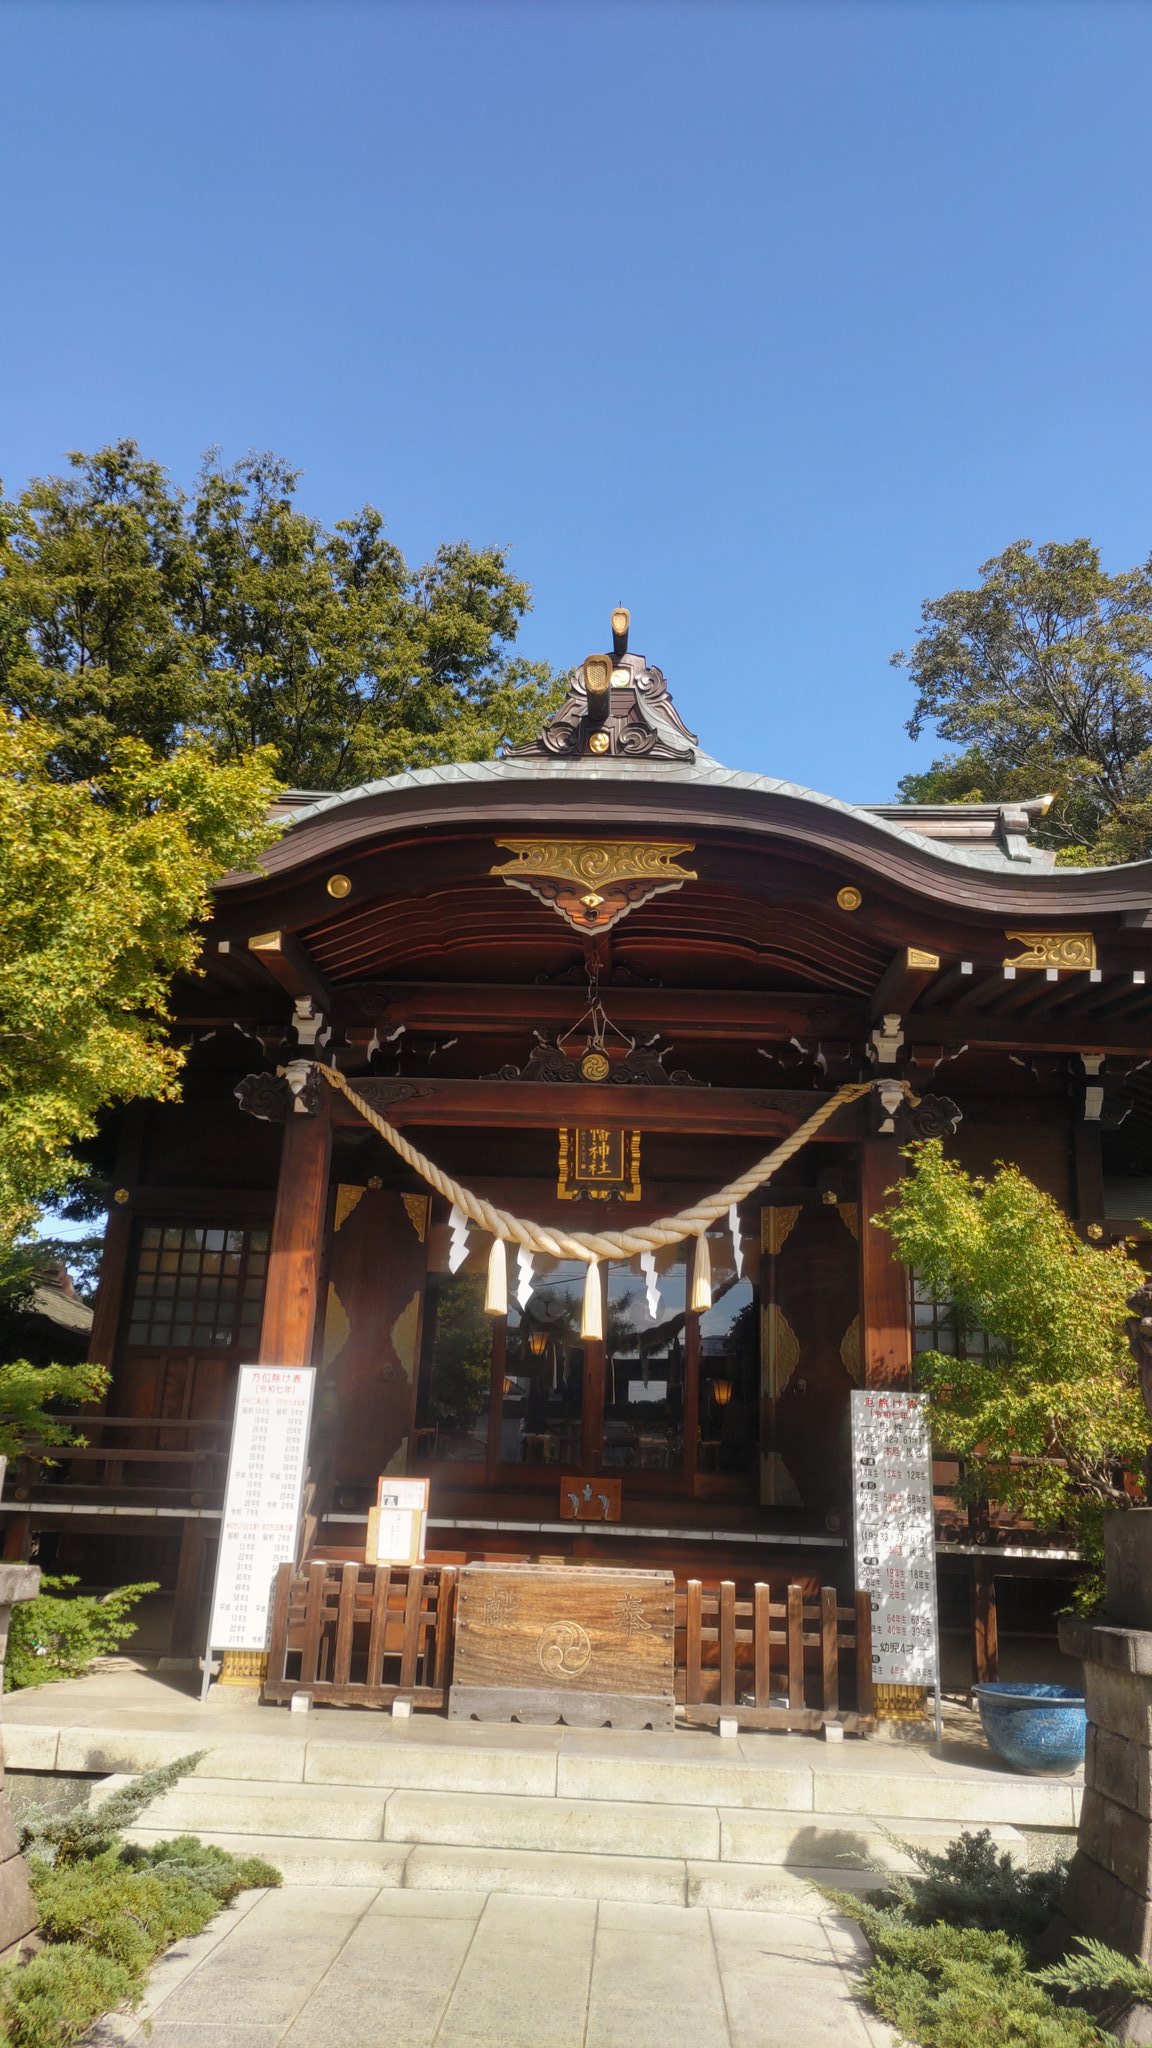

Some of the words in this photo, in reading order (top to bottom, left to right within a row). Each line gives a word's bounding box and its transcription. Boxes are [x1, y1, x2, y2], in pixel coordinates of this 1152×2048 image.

[252, 1372, 302, 1383] 方位除け表
[256, 1384, 296, 1394] (令和七年)
[870, 1408, 912, 1420] (令和七年)
[884, 1446, 901, 1457] 本厄
[907, 1470, 926, 1480] 12年生
[907, 1494, 926, 1504] 58年生
[886, 1568, 905, 1579] 19年生
[911, 1569, 930, 1580] 18年生
[889, 1579, 906, 1590] 5年生
[914, 1581, 930, 1591] 4年生
[612, 1592, 652, 1638] 奉
[886, 1613, 907, 1624] 64年生
[887, 1626, 907, 1636] 40年生
[911, 1627, 932, 1637] 39年生
[880, 1642, 914, 1655] 幼児4才
